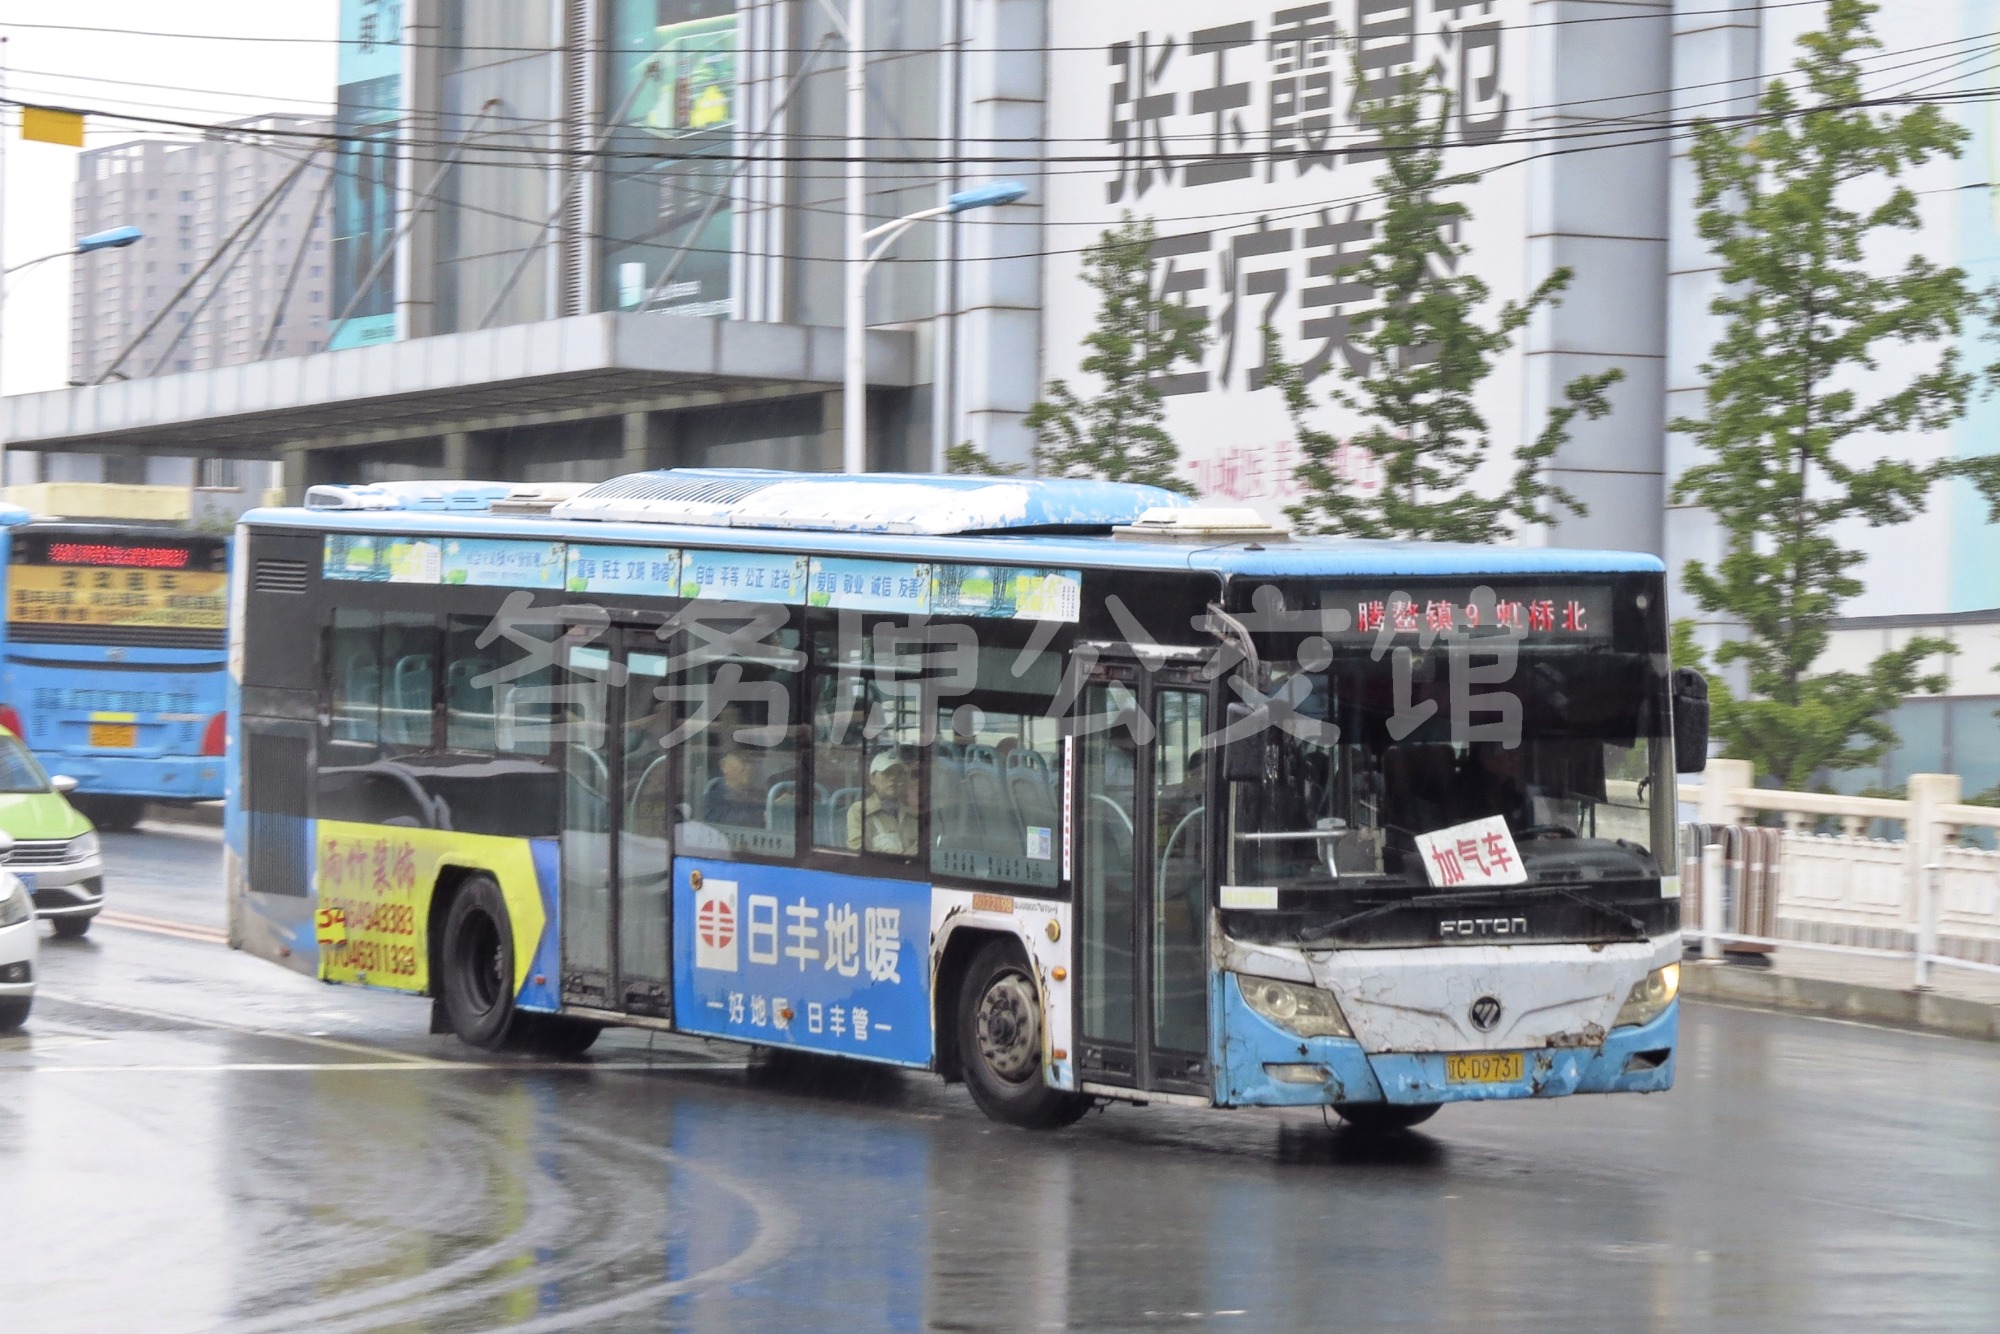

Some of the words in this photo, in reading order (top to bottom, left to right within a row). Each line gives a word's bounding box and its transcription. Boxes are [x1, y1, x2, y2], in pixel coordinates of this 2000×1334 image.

[696, 565, 714, 585] 自由
[720, 566, 739, 587] 平等
[745, 567, 765, 588] 公正
[817, 572, 836, 593] 爱国
[843, 573, 864, 594] 敬业
[871, 575, 892, 597] 诚信
[898, 576, 919, 599] 友善
[1431, 831, 1513, 887] 加气车
[747, 894, 901, 984] 日丰地暖
[1439, 917, 1528, 936] FOTON
